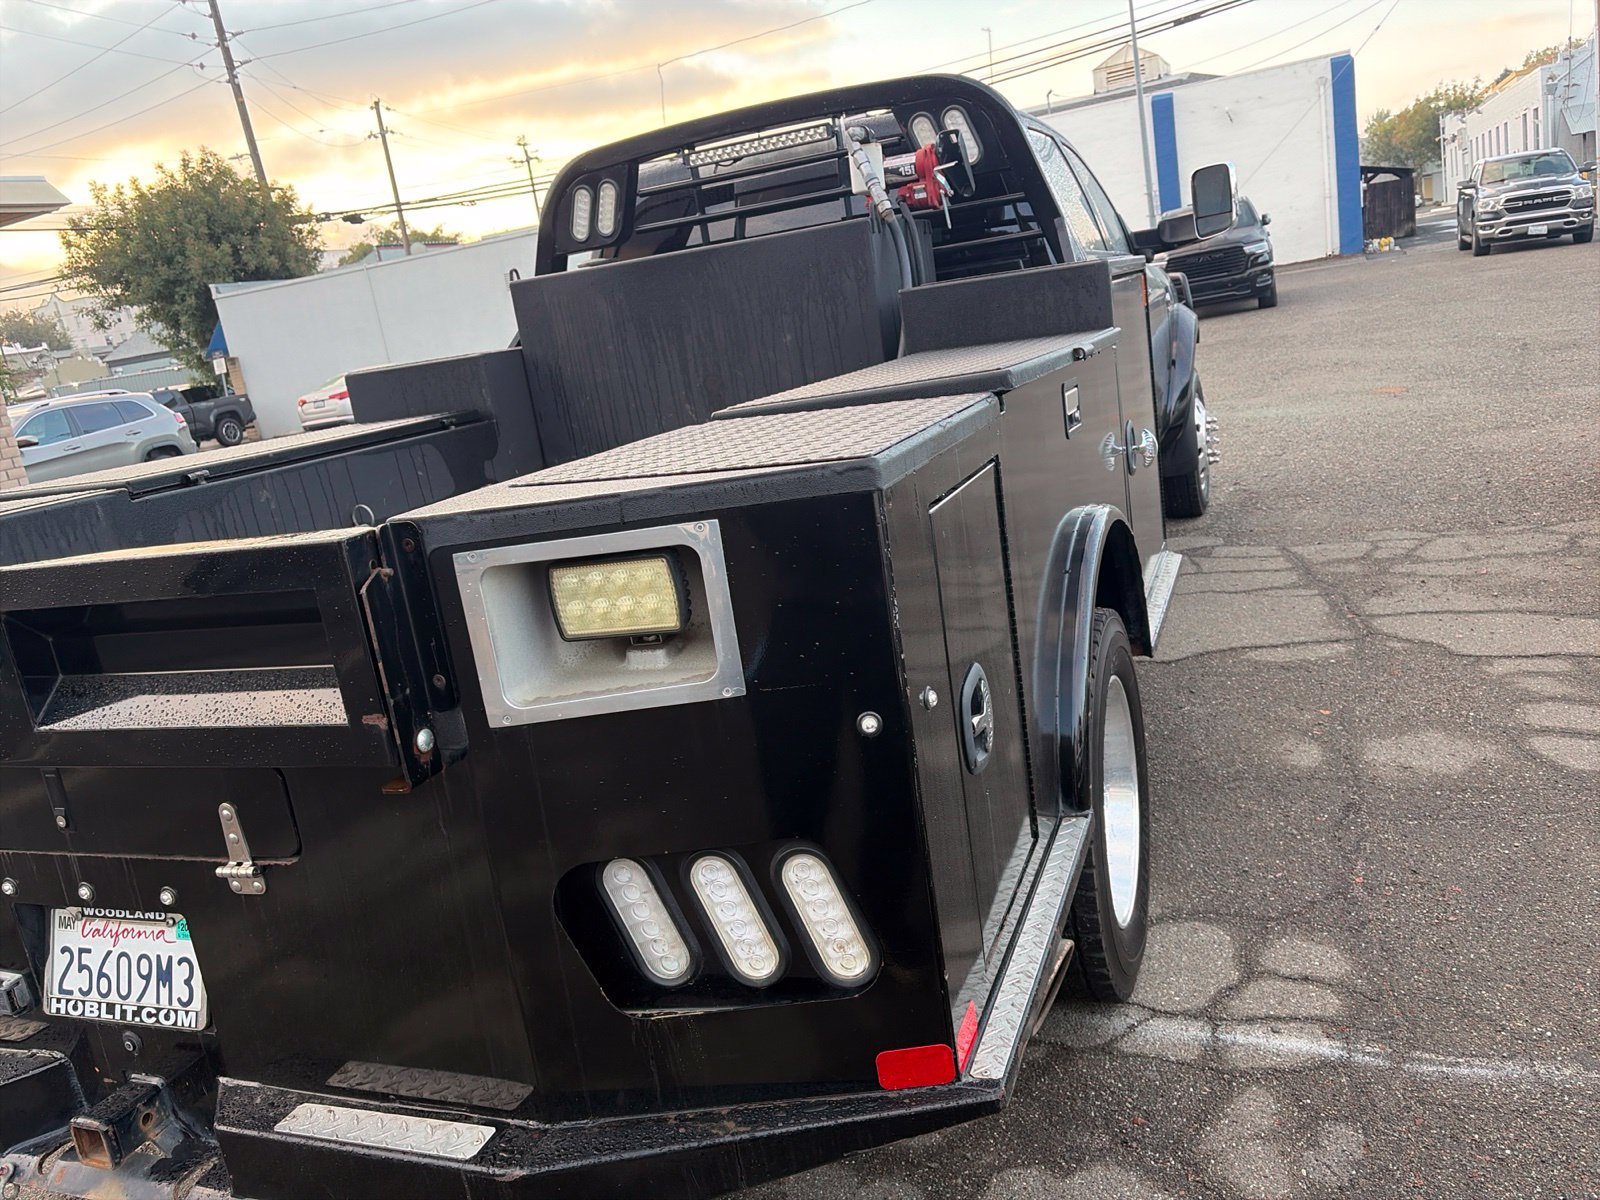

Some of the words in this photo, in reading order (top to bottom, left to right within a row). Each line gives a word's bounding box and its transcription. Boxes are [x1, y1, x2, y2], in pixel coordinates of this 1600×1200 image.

[1523, 197, 1552, 205] RAM
[58, 915, 77, 930] MAY
[82, 907, 166, 920] WOODLAND
[81, 919, 177, 948] California
[57, 945, 195, 1008] 25609M3
[50, 998, 197, 1028] HOBLIT.COM
